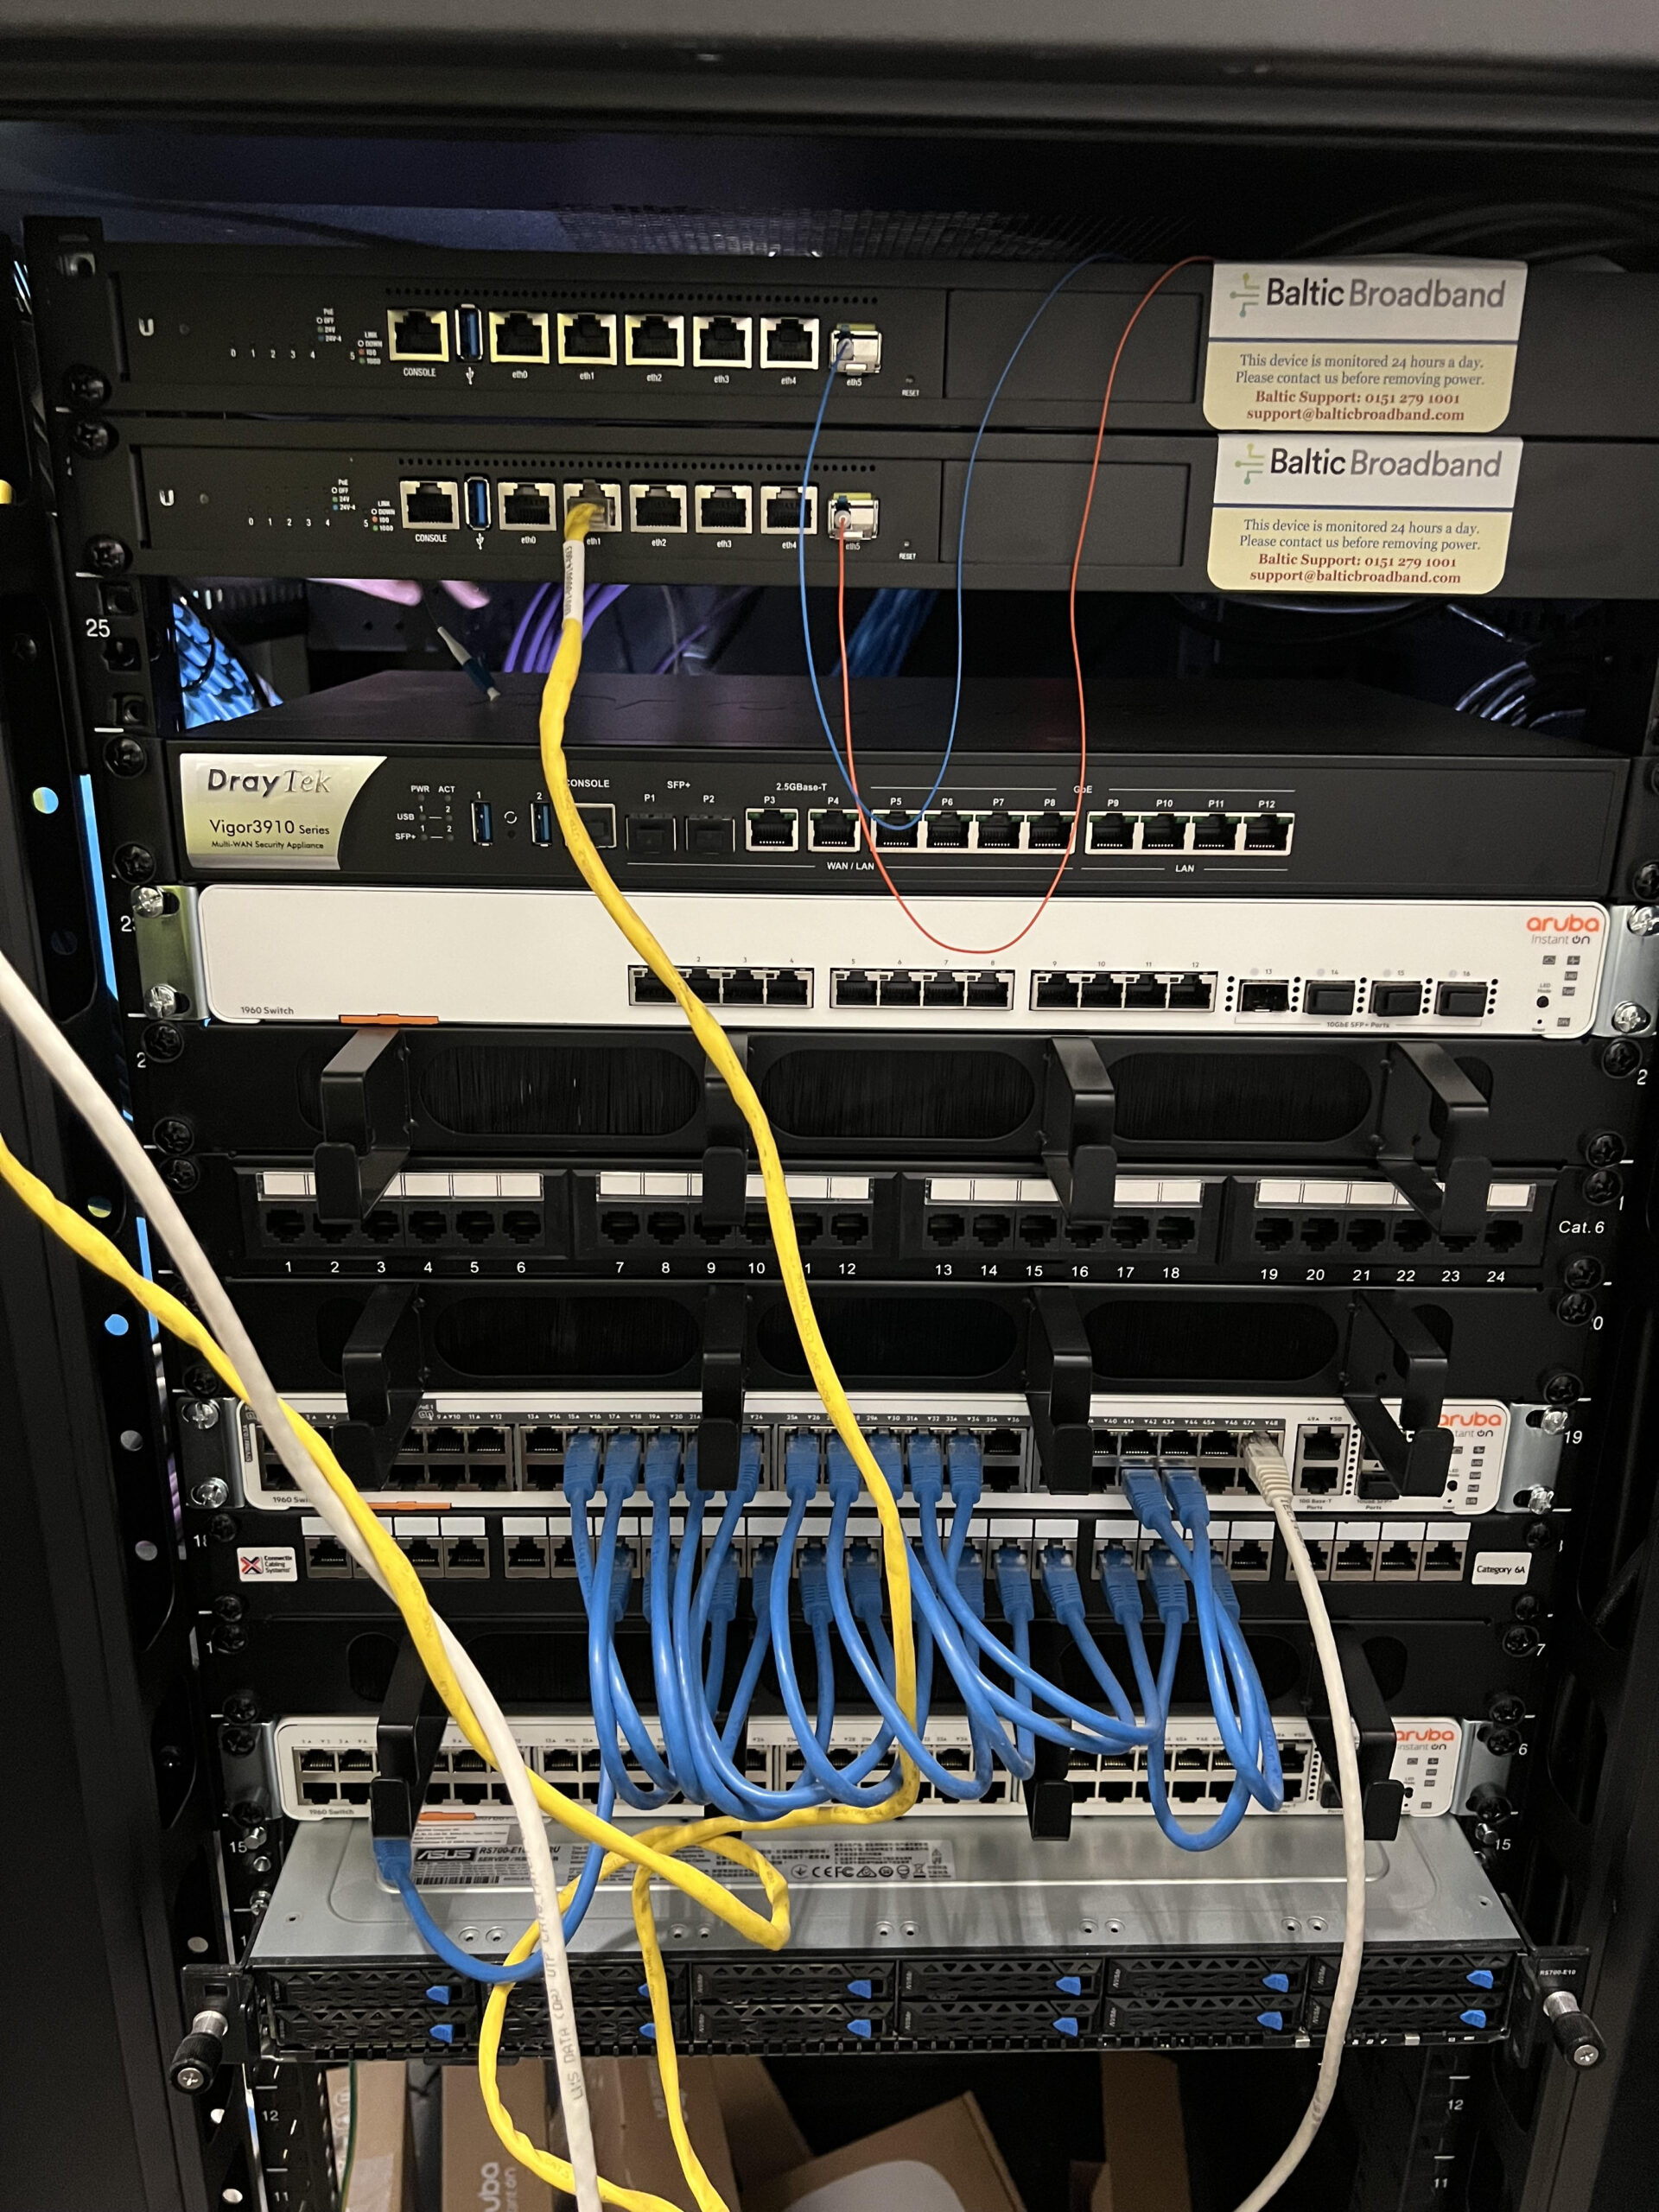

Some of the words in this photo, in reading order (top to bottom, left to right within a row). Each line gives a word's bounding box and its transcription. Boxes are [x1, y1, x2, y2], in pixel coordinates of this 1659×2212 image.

[1267, 278, 1344, 306] Baltic
[1350, 279, 1505, 308] Broadband
[1240, 354, 1267, 366] This
[1269, 354, 1309, 367] device
[1311, 355, 1322, 367] is
[1325, 355, 1388, 367] monitored
[1392, 358, 1407, 370] 24
[1410, 356, 1446, 368] hours
[1448, 359, 1455, 368] a
[1459, 356, 1484, 371] day.
[403, 368, 436, 378] CONSOLE
[512, 369, 527, 379] eth0
[580, 372, 594, 381] eth1
[647, 372, 662, 383] eth2
[714, 374, 729, 384] eth3
[781, 376, 797, 385] eth4
[847, 378, 862, 387] eth5
[1236, 371, 1274, 383] Please
[1277, 372, 1320, 384] contact
[1325, 375, 1338, 384] us
[1341, 372, 1380, 385] before
[1382, 373, 1440, 387] removing
[1444, 376, 1484, 388] power.
[1255, 391, 1296, 403] Baltic
[1299, 391, 1361, 405] Support:
[1365, 394, 1395, 405] 0151
[1400, 395, 1423, 406] 279
[1428, 395, 1459, 404] 1001
[1247, 408, 1465, 422] support@balticbroadband.com
[1270, 448, 1345, 475] Baltic
[1351, 449, 1502, 477] Broadband
[1244, 518, 1269, 531] This
[1273, 519, 1310, 531] device
[1313, 520, 1322, 532] is
[1325, 520, 1387, 532] monitored
[1390, 524, 1405, 535] 24
[1408, 521, 1443, 533] hours
[1455, 522, 1479, 537] day.
[415, 534, 448, 543] CONSOLE
[521, 535, 537, 544] eth0
[587, 537, 601, 546] eth1
[652, 538, 666, 547] eth2
[717, 539, 732, 549] eth3
[782, 540, 797, 550] eth4
[845, 542, 861, 550] eth5
[1240, 535, 1276, 547] Please
[1280, 537, 1322, 548] contact
[1325, 539, 1338, 548] us
[1343, 536, 1379, 549] before
[1382, 538, 1438, 551] removing
[1441, 540, 1480, 552] power.
[1259, 554, 1297, 565] Baltic
[1300, 555, 1361, 569] Support:
[1365, 557, 1393, 569] 0151
[1398, 558, 1421, 569] 279
[1426, 559, 1456, 568] 1001
[1250, 570, 1461, 584] support@balticbroadband.com
[86, 620, 110, 637] 25
[208, 769, 331, 796] DrayTek
[777, 783, 828, 791] 2.5GBase-T
[477, 791, 481, 800] 1
[645, 794, 655, 803] P1
[764, 796, 775, 804] P3
[942, 798, 953, 806] P6
[1258, 800, 1275, 809] P12
[210, 819, 295, 836] Vigor3910
[300, 825, 330, 835] Series
[395, 832, 416, 841] SFP+
[255, 841, 284, 850] Security
[287, 841, 323, 850] Appliance
[1527, 914, 1599, 931] aruba
[240, 1006, 262, 1014] 1960
[264, 1006, 294, 1015] Switch
[1559, 1221, 1591, 1234] Cat.
[1595, 1221, 1605, 1234] 6
[286, 1262, 291, 1273] 1
[330, 1262, 339, 1273] 2
[377, 1262, 385, 1273] 3
[423, 1262, 433, 1273] 4
[470, 1262, 479, 1273] 5
[517, 1262, 525, 1274] 6
[616, 1262, 624, 1273] 7
[661, 1262, 671, 1274] 8
[707, 1262, 715, 1274] 9
[748, 1263, 766, 1274] 10
[839, 1263, 856, 1274] 12
[935, 1264, 952, 1275] 13
[981, 1265, 998, 1276] 14
[1026, 1266, 1043, 1276] 15
[1071, 1266, 1089, 1277] 16
[1117, 1267, 1135, 1278] 17
[1163, 1268, 1179, 1278] 18
[1261, 1268, 1278, 1280] 19
[1306, 1269, 1325, 1281] 20
[1353, 1269, 1370, 1281] 21
[1396, 1270, 1415, 1282] 22
[1442, 1271, 1460, 1282] 23
[1487, 1271, 1505, 1283] 24
[1564, 1431, 1582, 1444] 19
[1477, 1565, 1512, 1575] Category
[230, 1841, 247, 1853] 15
[1496, 1839, 1511, 1851] 15
[417, 1850, 472, 1859] ASUS
[560, 2027, 575, 2064] DATA
[1448, 2100, 1464, 2110] 12
[262, 2110, 279, 2121] 12
[1434, 2178, 1448, 2188] 11
[275, 2191, 289, 2202] 11
